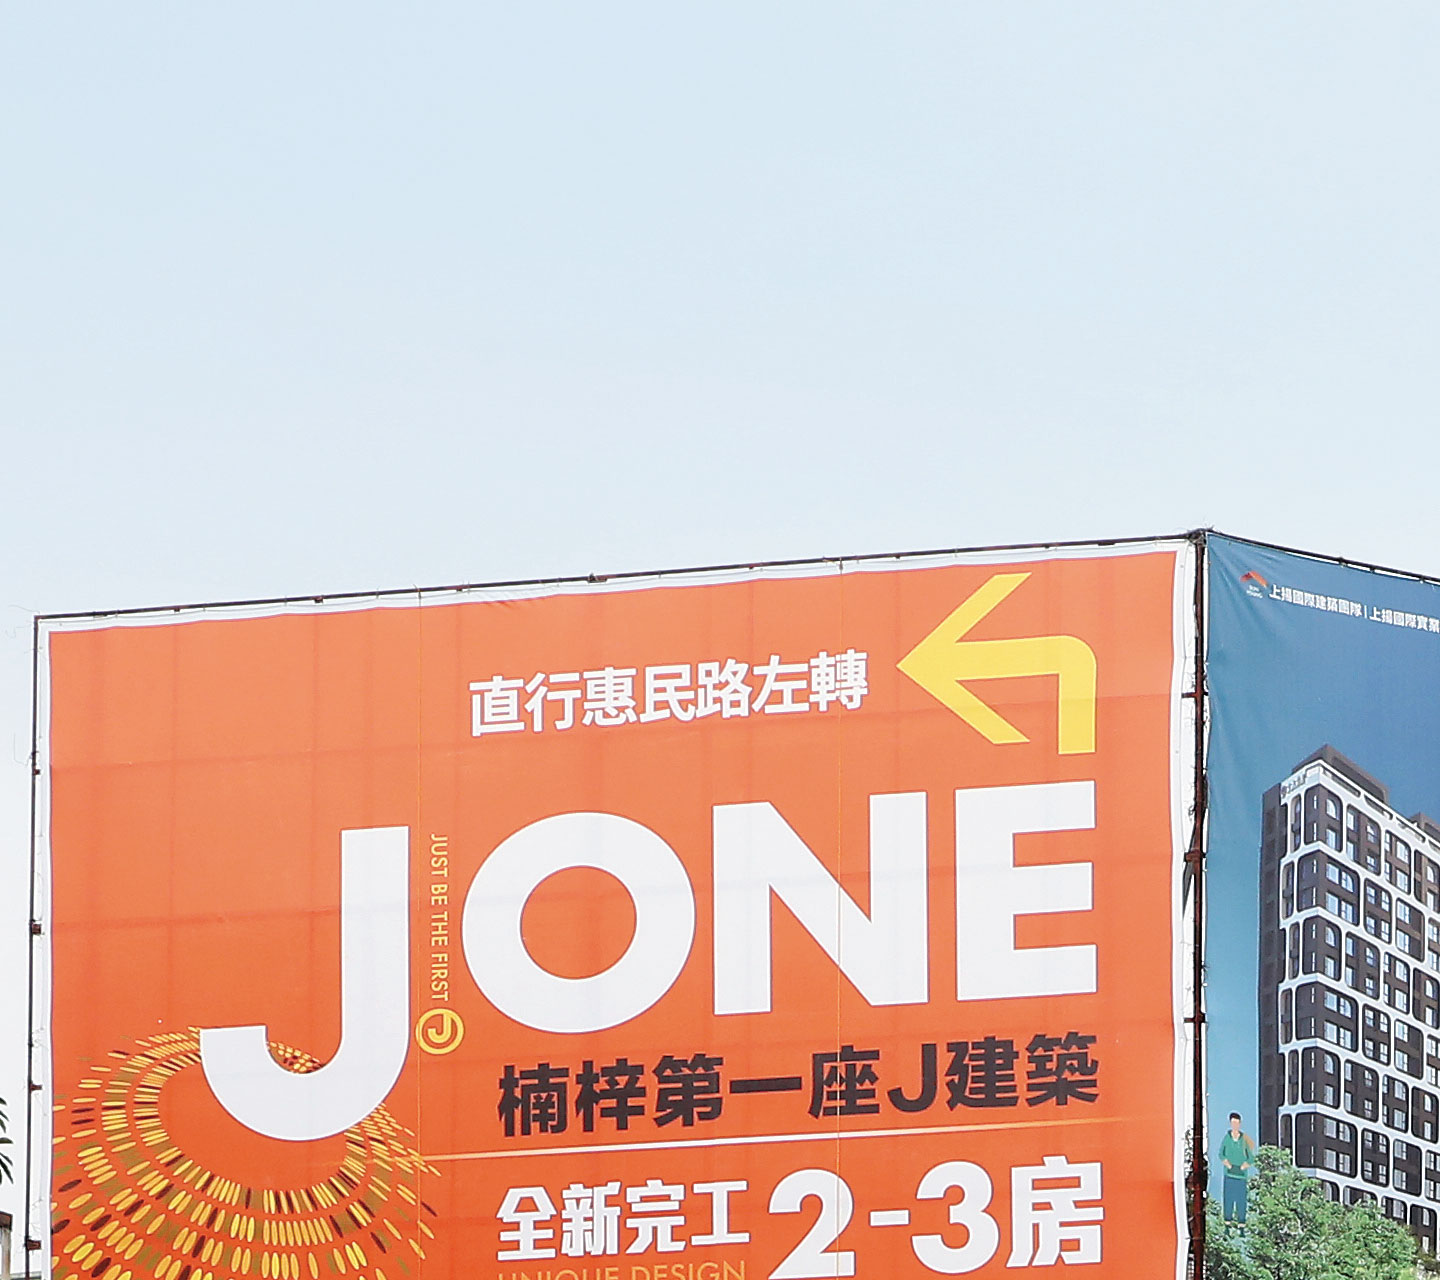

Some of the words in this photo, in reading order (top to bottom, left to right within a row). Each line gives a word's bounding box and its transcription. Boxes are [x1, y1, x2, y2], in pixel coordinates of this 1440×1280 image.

[468, 648, 869, 737] 直行惠民路左轉
[429, 833, 449, 878] JUST
[429, 883, 449, 906] BE
[429, 910, 449, 947] THE
[429, 952, 449, 1002] FIRST
[495, 1031, 1101, 1138] 楠梓第一座J建築
